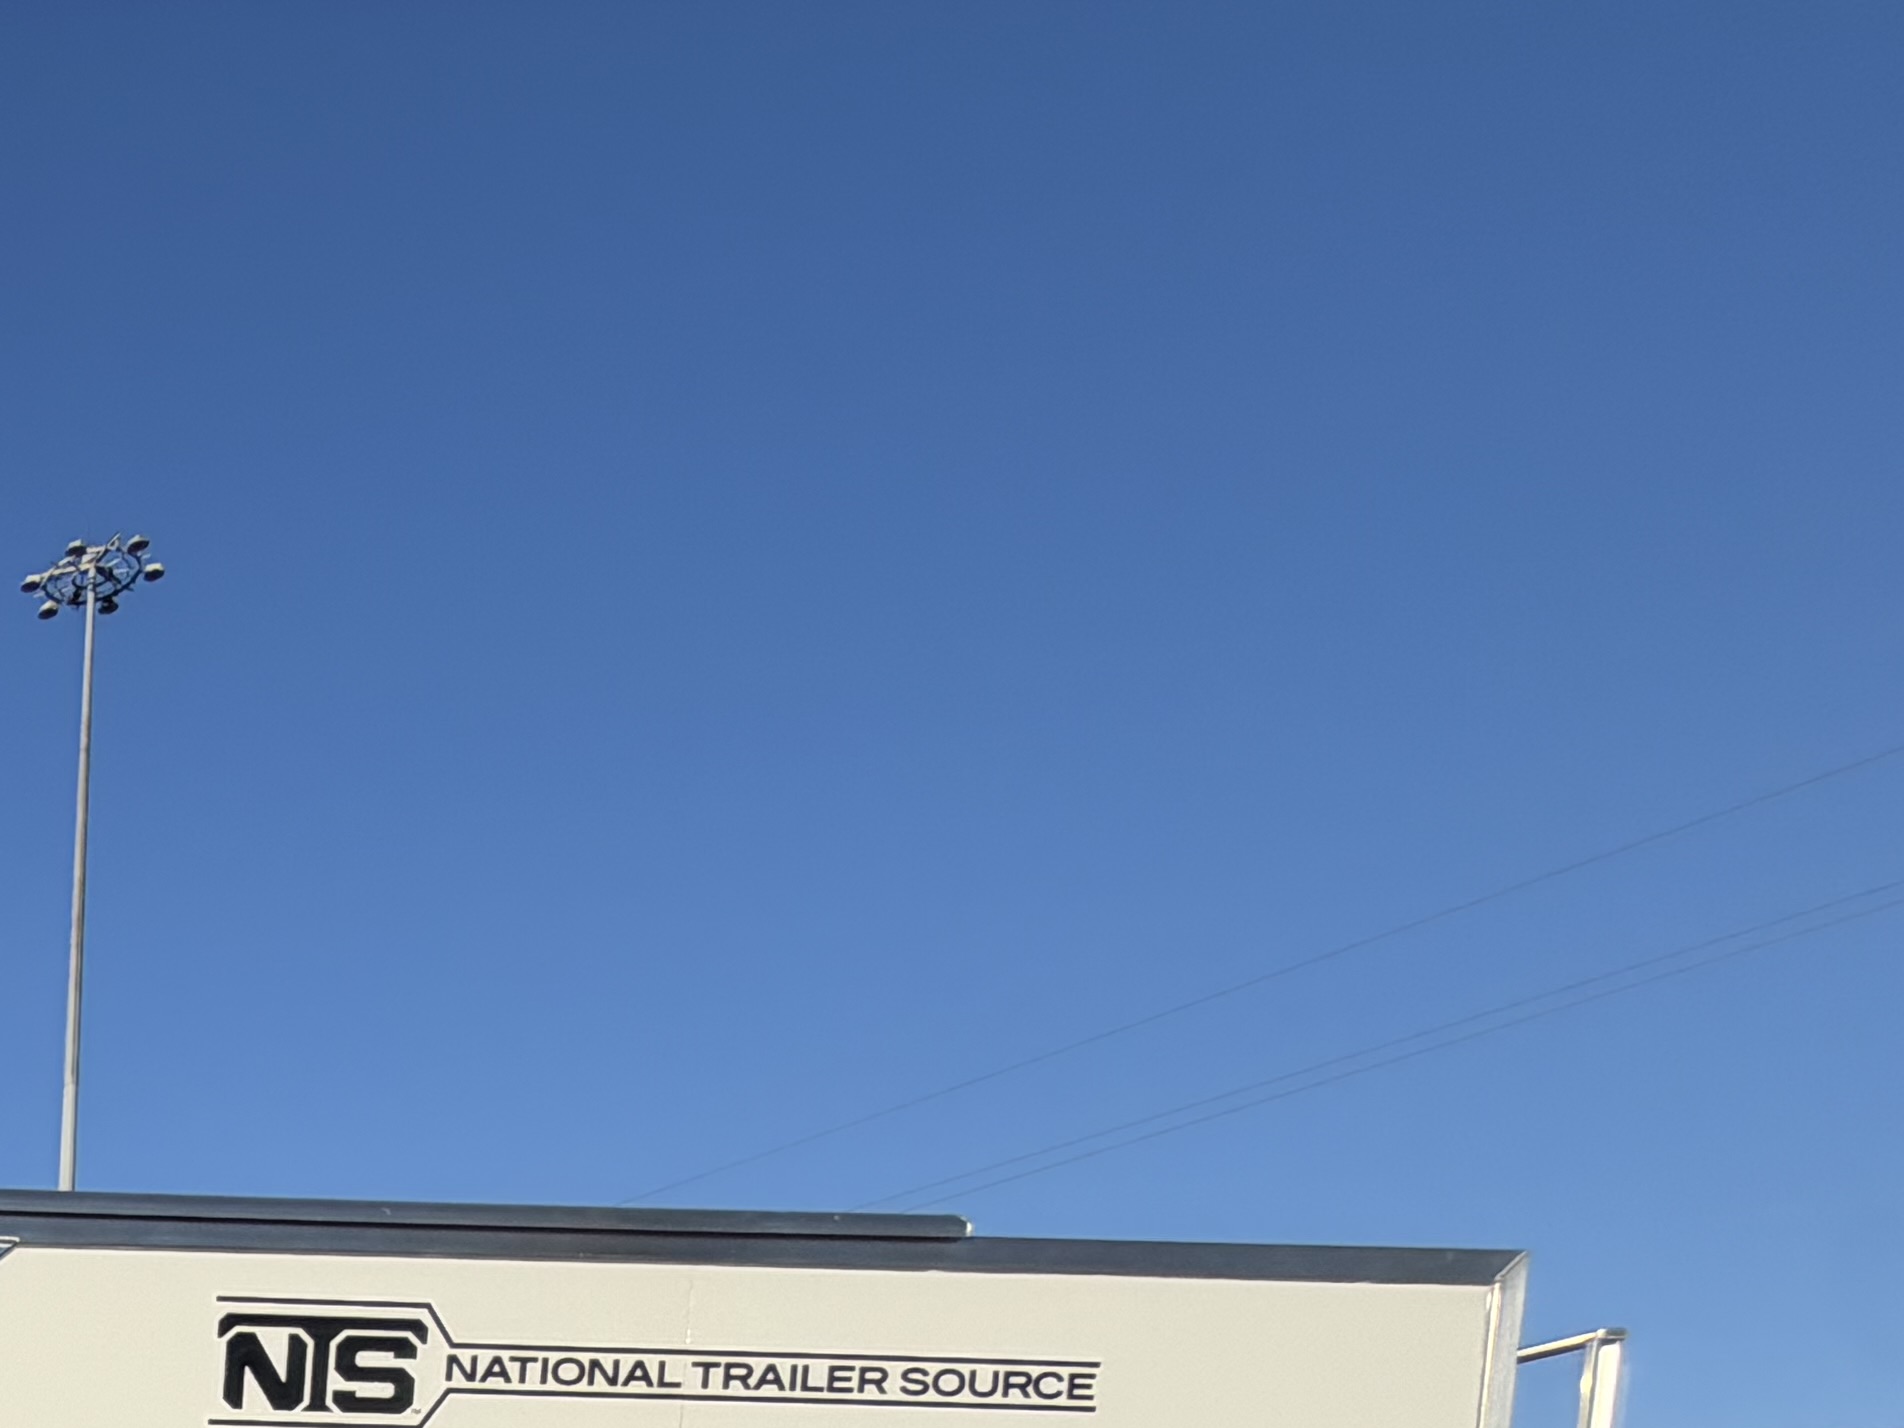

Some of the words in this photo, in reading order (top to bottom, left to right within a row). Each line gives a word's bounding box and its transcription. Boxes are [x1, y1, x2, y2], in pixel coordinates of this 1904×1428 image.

[217, 1312, 429, 1415] NTS
[444, 1354, 682, 1389] NATIONAL
[691, 1361, 889, 1395] TRAILER
[899, 1367, 1097, 1401] SOURCE
